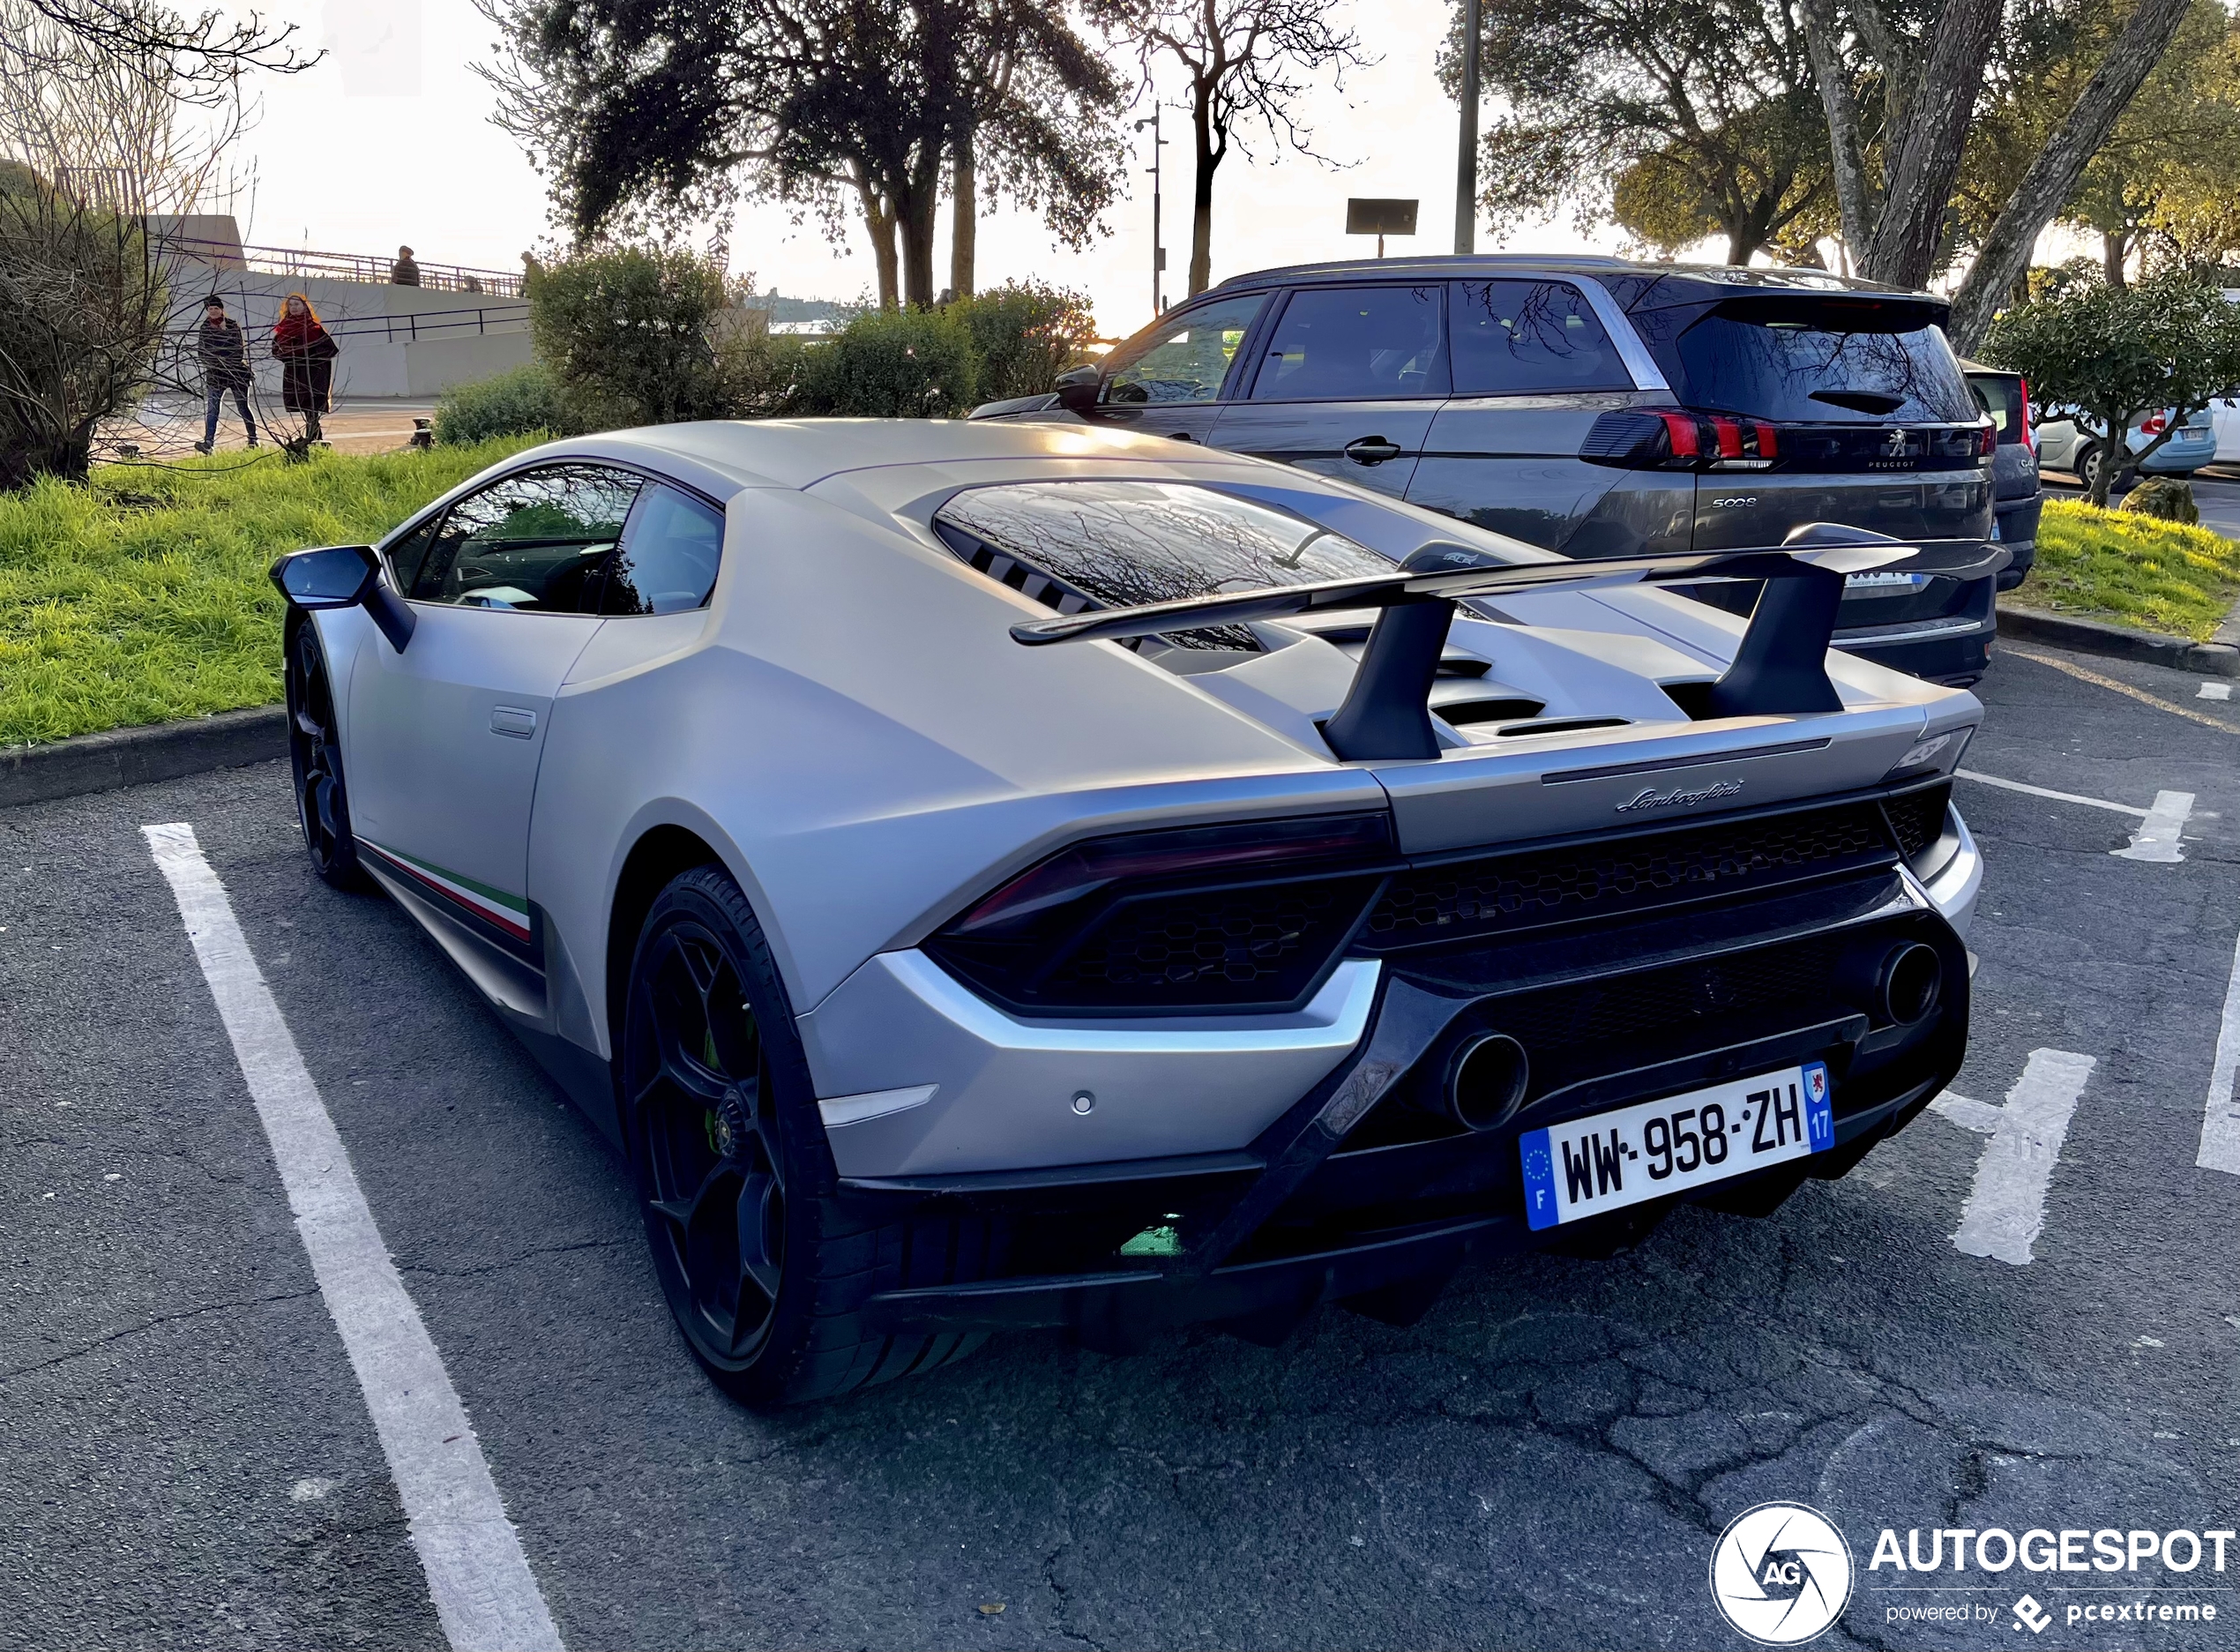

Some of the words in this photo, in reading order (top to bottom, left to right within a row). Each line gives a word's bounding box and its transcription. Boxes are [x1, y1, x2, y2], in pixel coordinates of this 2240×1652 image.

[1712, 497, 1758, 509] 5008
[1615, 780, 1744, 812] Lamborghini
[1811, 1110, 1829, 1141] 17
[1561, 1083, 1802, 1204] WW-958-ZH
[1535, 1190, 1545, 1210] F
